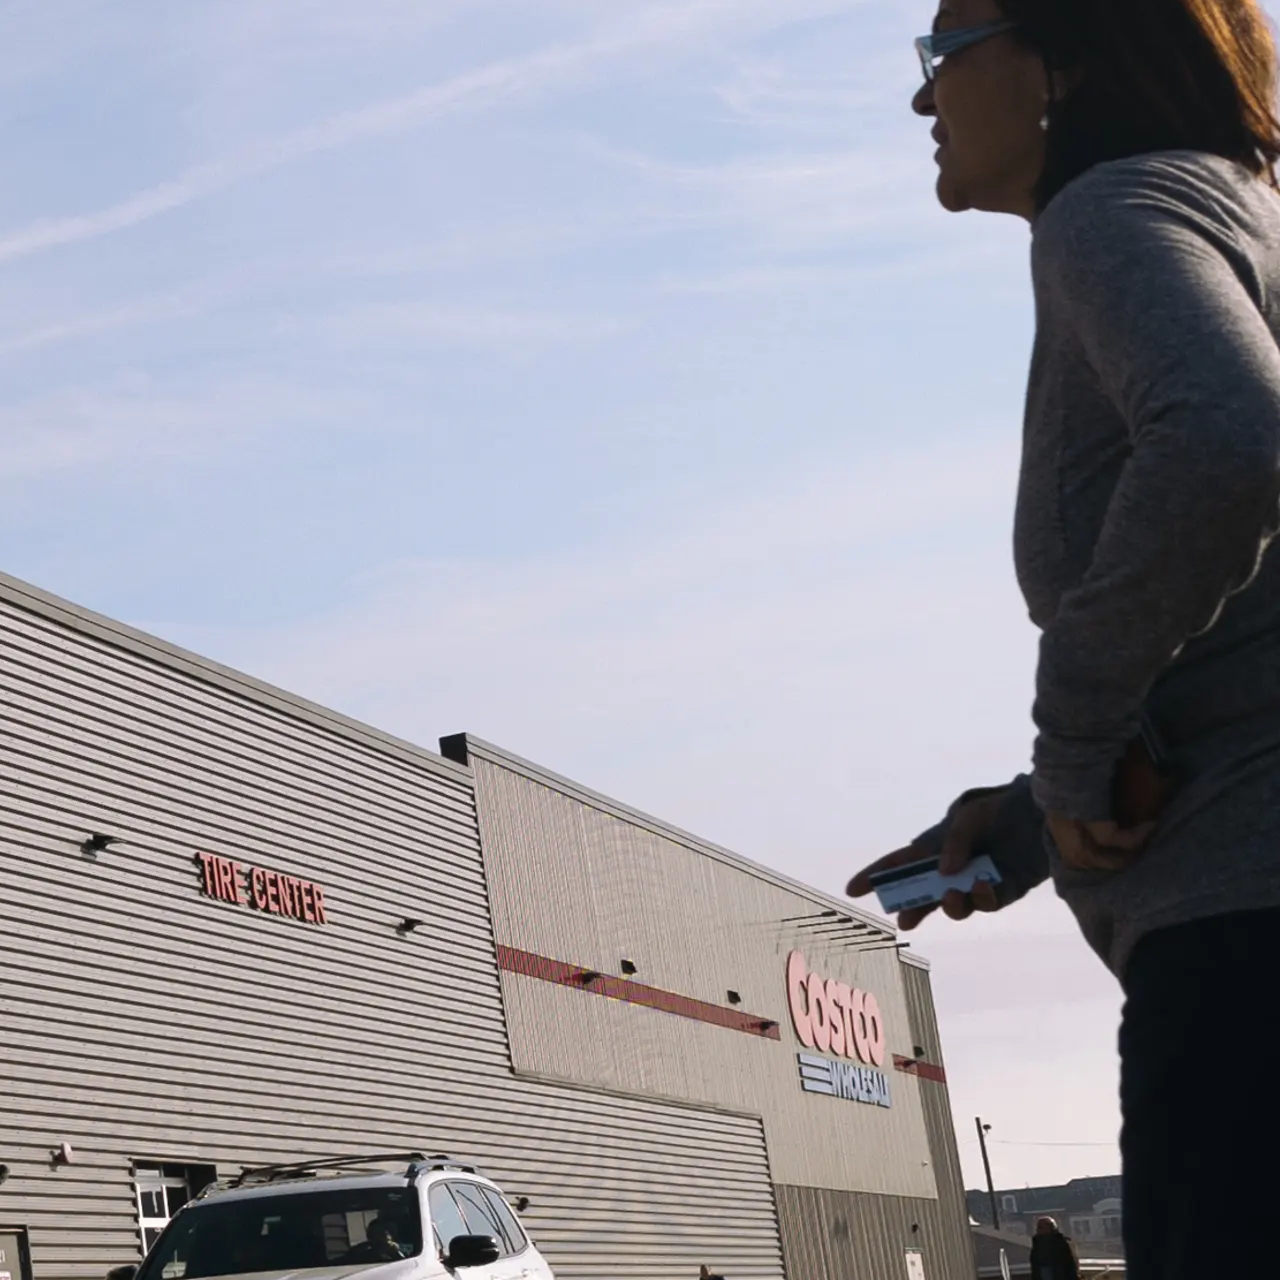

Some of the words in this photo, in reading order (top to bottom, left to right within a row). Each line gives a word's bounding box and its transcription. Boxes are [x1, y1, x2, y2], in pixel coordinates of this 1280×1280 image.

[197, 851, 249, 904] TIRE
[250, 866, 328, 924] CENTER
[786, 949, 885, 1067] COSTCO
